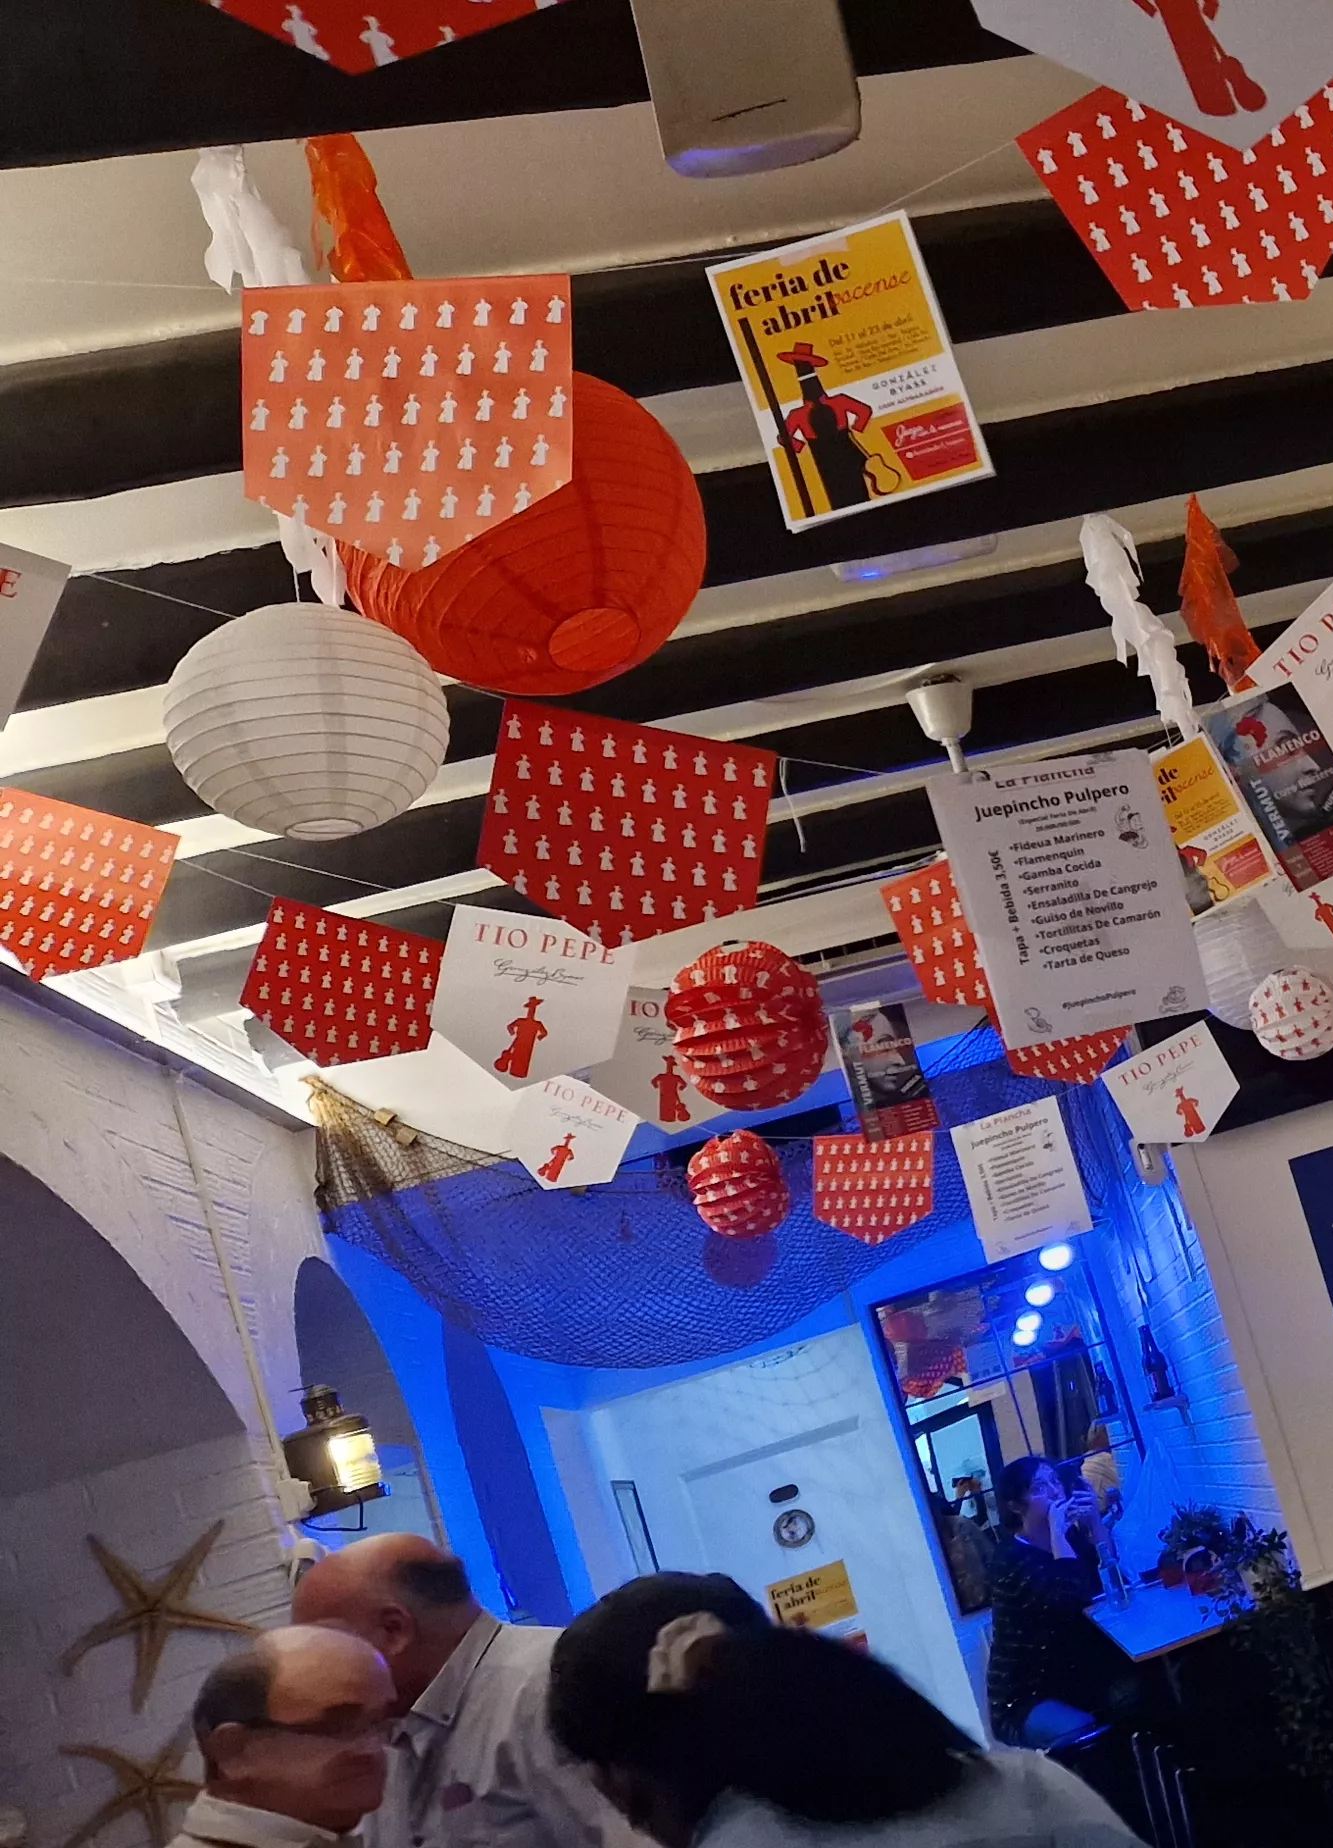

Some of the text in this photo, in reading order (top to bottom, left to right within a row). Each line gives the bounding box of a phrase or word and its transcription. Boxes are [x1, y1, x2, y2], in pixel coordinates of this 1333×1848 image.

[729, 259, 850, 311] feria de
[761, 291, 841, 336] abril
[1272, 634, 1319, 678] TIO
[1253, 730, 1321, 767] FLAMENCO
[1158, 768, 1179, 786] de
[975, 793, 1060, 823] Juepincho
[1064, 783, 1130, 807] Pulpero
[1250, 778, 1291, 842] VERMUT
[1054, 829, 1105, 845] Marinero
[1022, 859, 1102, 881] Gamba Cocida
[1000, 882, 1019, 923] Bebida
[1027, 879, 1079, 896] Serranito
[1031, 879, 1158, 910] Ensaladilla De Cangrejo
[1036, 901, 1124, 925] Guiso de Novillo
[475, 922, 616, 966] TIO PEPE
[1039, 923, 1094, 940] Tortillitas
[1096, 918, 1110, 929] De
[1015, 936, 1030, 965] Tapa
[1043, 938, 1100, 956] Croquetas
[1047, 947, 1130, 971] Tarta de Queso
[629, 1000, 660, 1018] IO
[1117, 1062, 1151, 1087] TIO
[1155, 1034, 1202, 1067] PEPE
[543, 1080, 575, 1103] TIO
[580, 1095, 630, 1124] PEPE
[970, 1117, 1048, 1150] Juepincho Pulpero
[770, 1583, 804, 1600] feria
[805, 1575, 820, 1588] de
[784, 1590, 816, 1610] abril
